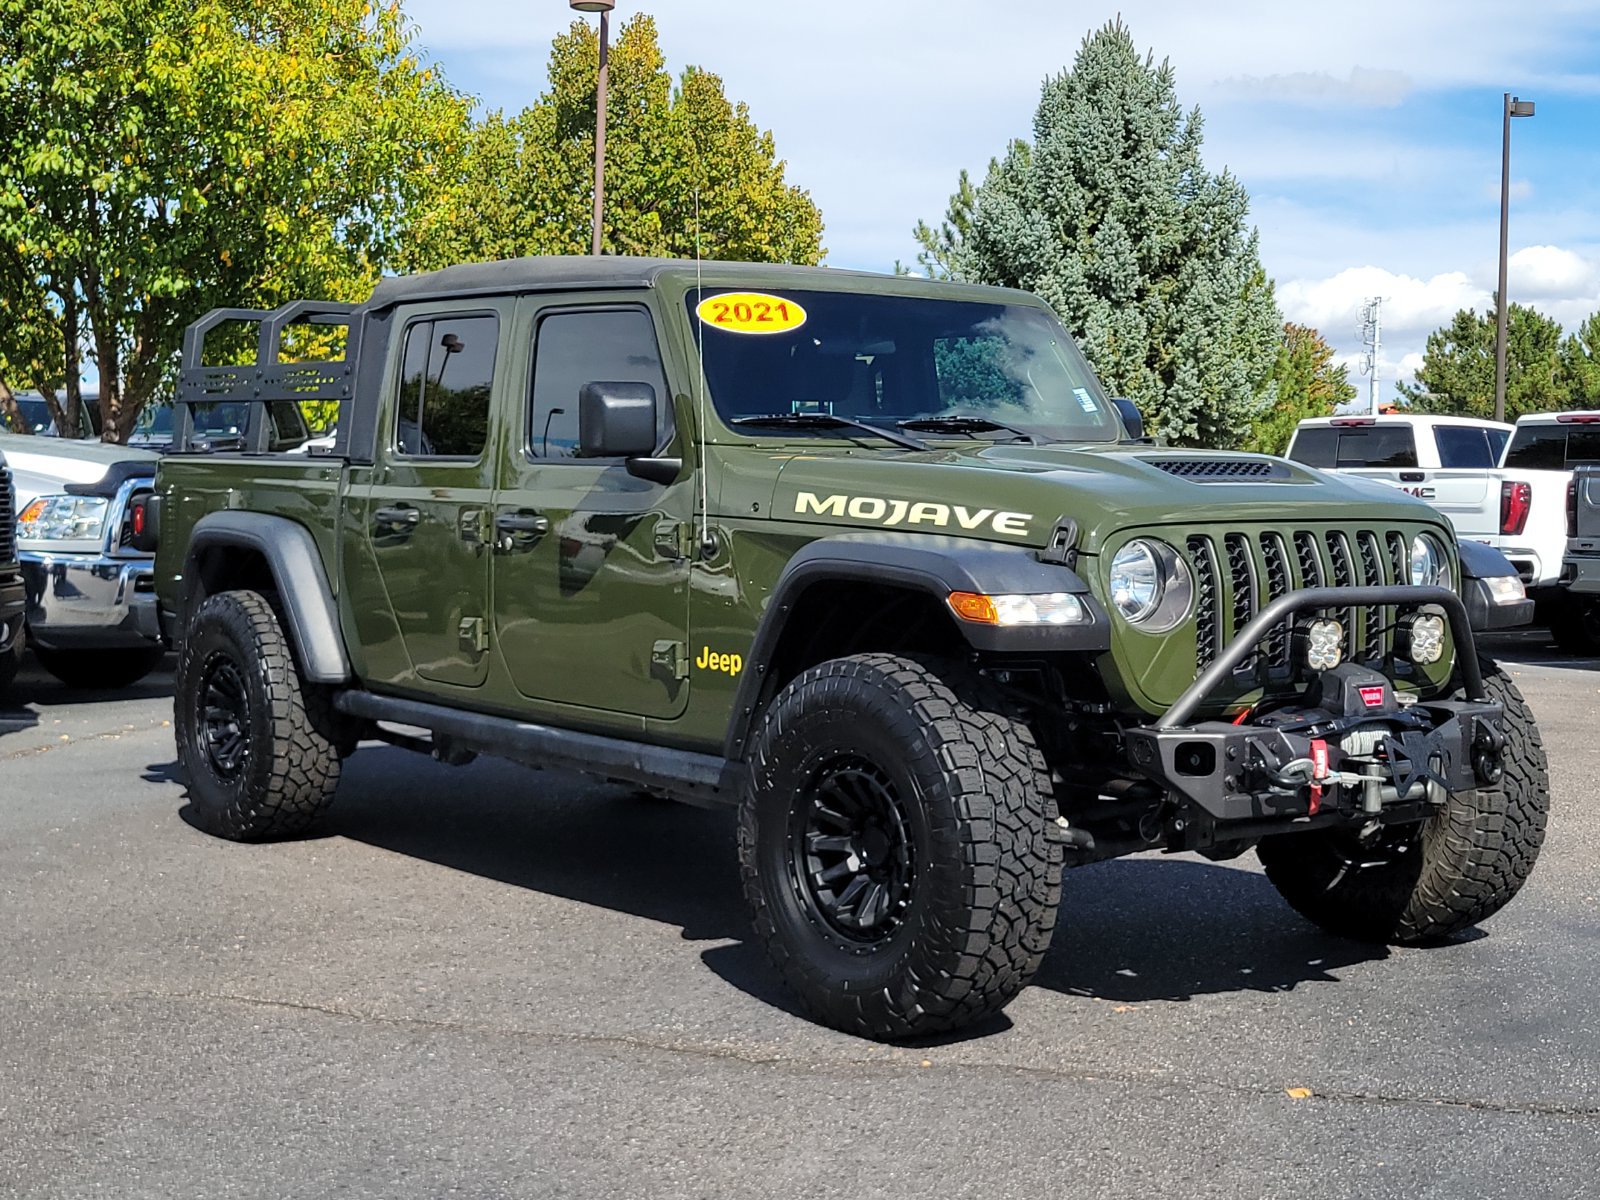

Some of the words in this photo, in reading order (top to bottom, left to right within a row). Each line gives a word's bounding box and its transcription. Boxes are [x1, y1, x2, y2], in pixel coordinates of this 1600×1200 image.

[712, 302, 789, 323] 2021
[1396, 487, 1436, 500] MC
[794, 491, 1034, 536] MOJAVE
[695, 646, 742, 676] Jeep
